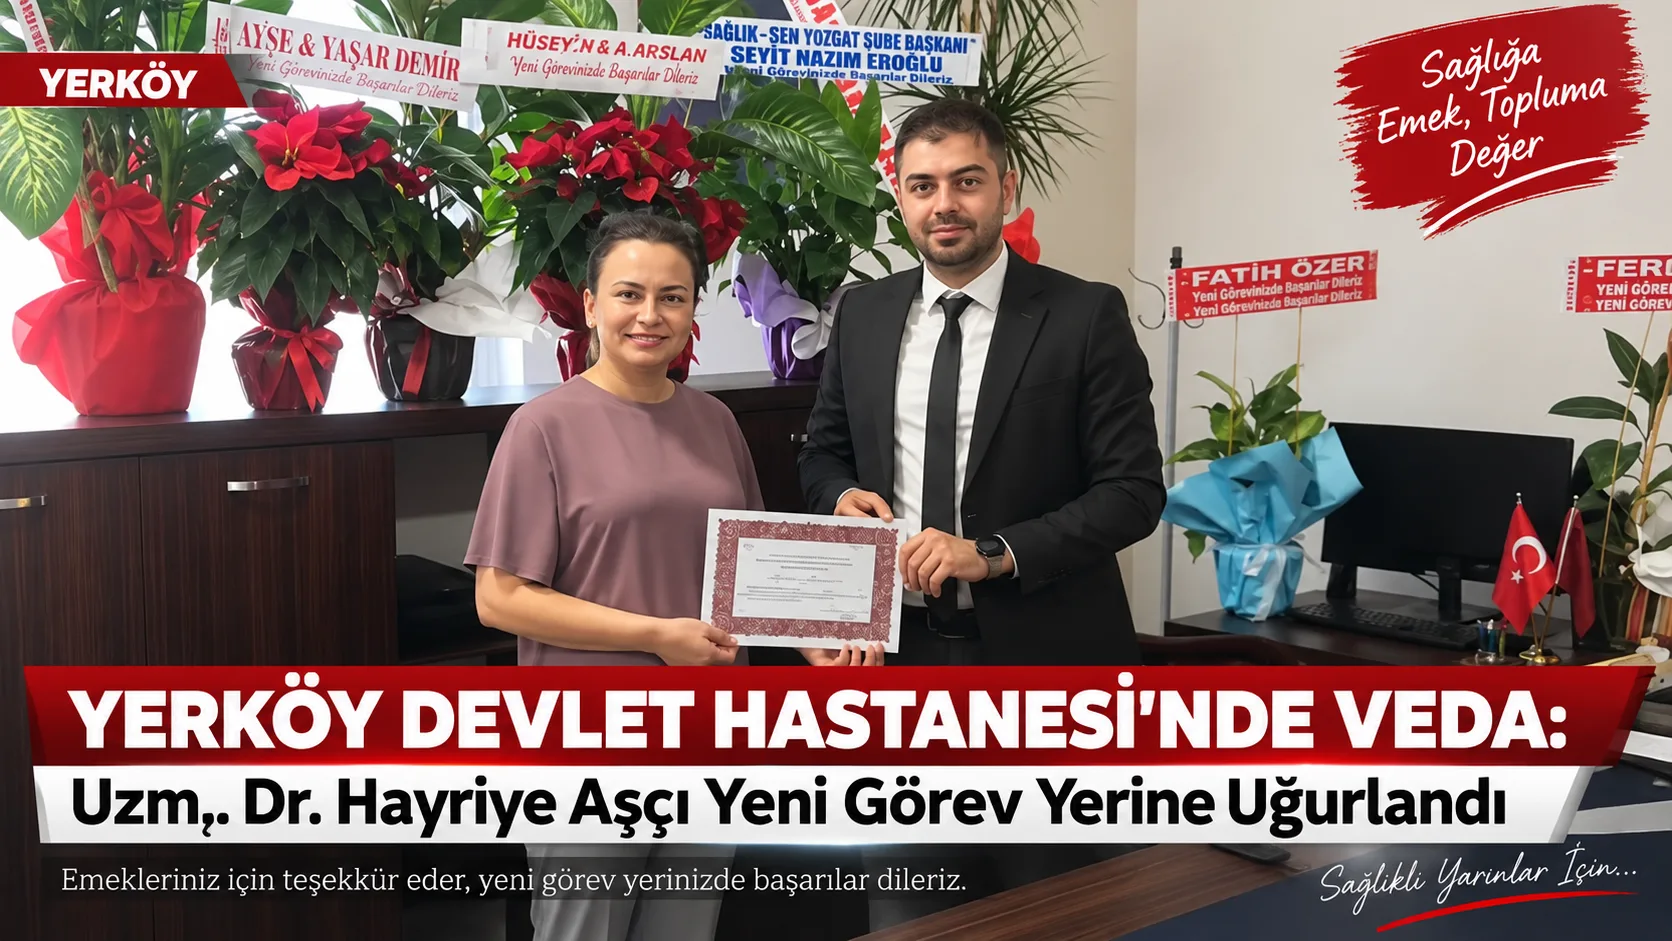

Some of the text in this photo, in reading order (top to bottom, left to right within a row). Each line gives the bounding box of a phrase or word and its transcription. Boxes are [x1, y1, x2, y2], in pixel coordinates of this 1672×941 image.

[597, 39, 609, 54] &
[804, 28, 860, 48] YOZGAT
[863, 32, 902, 52] ŞUBE
[905, 34, 968, 55] BAŞKANI
[298, 33, 316, 57] &
[323, 35, 390, 71] YAŞAR
[394, 48, 461, 81] DEMİR
[510, 56, 699, 85] Yeni Görevinizde Başarılar Dileriz
[730, 44, 943, 73] SEYİT NAZIM EROĞLU
[248, 54, 459, 102] Yeni Görevinizde Başarılar Dileriz
[1192, 256, 1365, 287] FATİH ÖZER
[1192, 288, 1217, 303] Yeni
[1596, 281, 1628, 295] YENİ
[1596, 296, 1626, 311] YENİ
